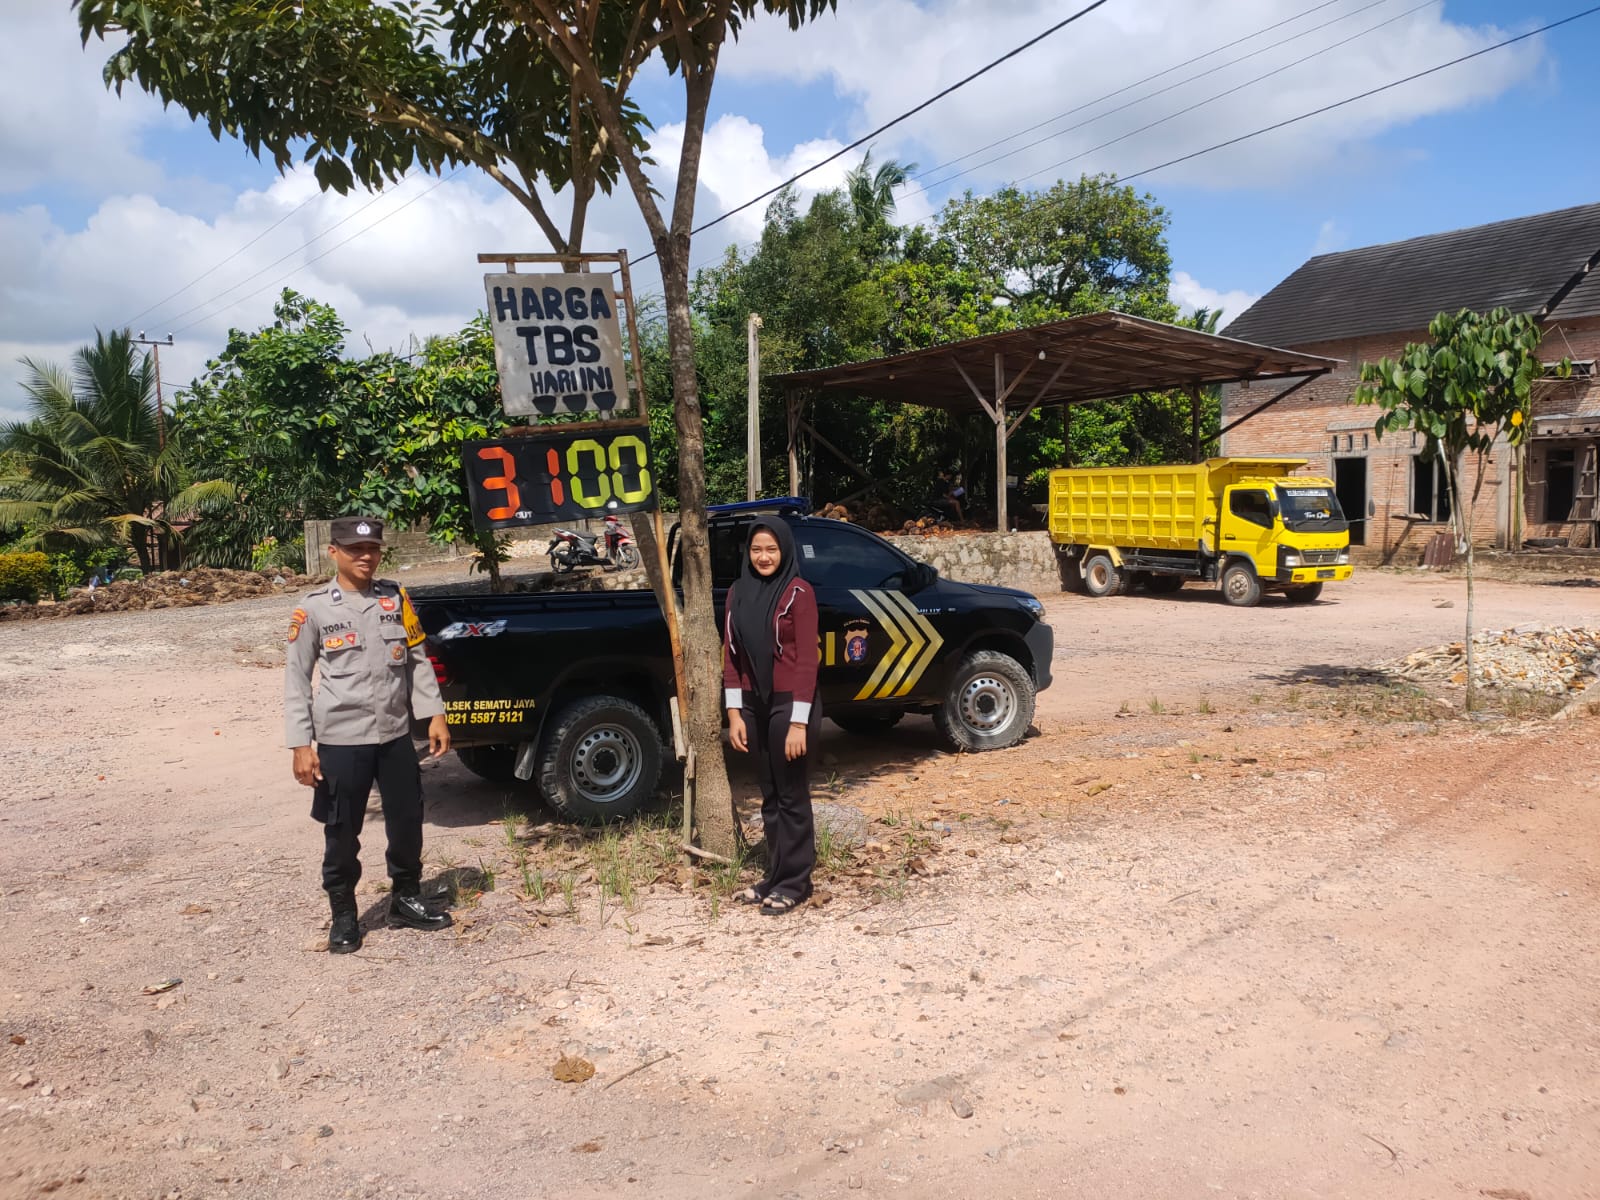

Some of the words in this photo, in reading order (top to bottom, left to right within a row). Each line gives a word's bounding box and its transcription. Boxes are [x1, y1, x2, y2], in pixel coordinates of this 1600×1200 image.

[493, 286, 612, 322] HARGA
[516, 325, 601, 366] TBS
[530, 370, 577, 394] HARI
[580, 366, 613, 391] INI
[470, 711, 496, 724] 5587
[498, 711, 523, 723] 5121
[474, 700, 511, 710] SEMATU
[514, 699, 535, 709] JAYA
